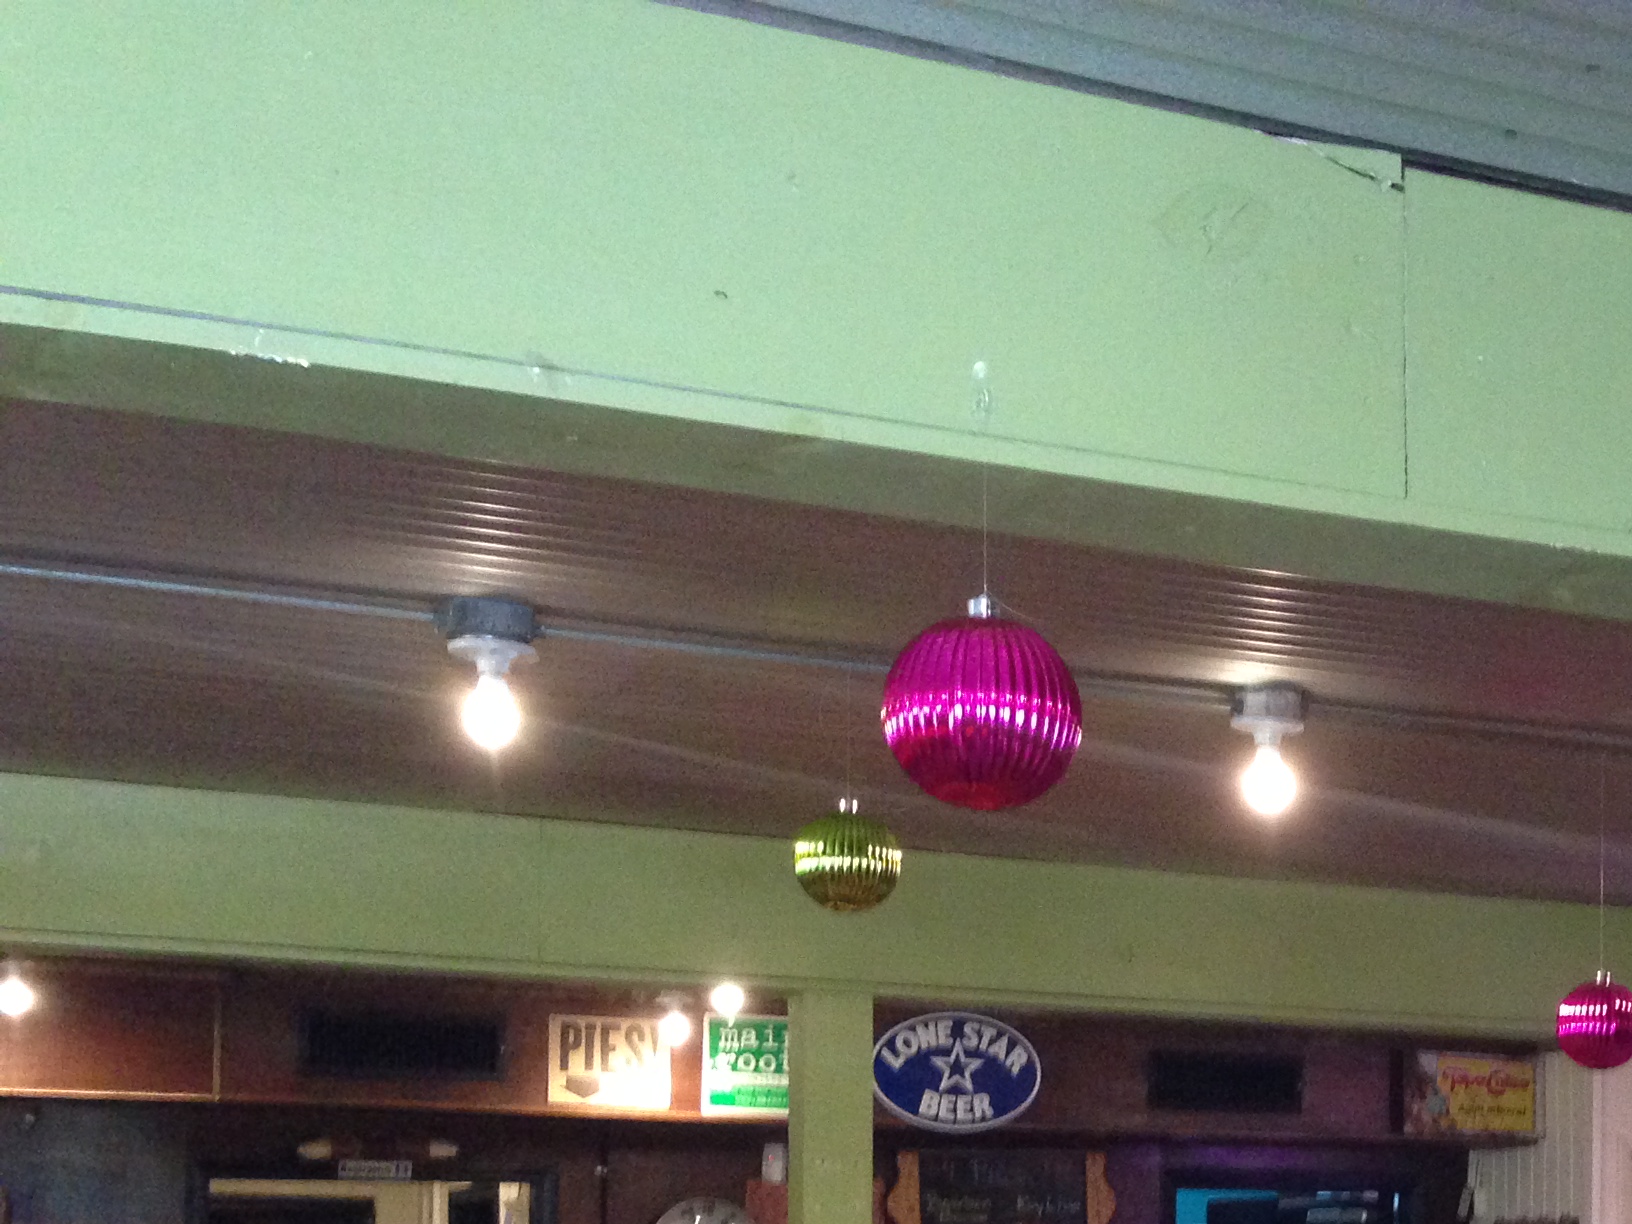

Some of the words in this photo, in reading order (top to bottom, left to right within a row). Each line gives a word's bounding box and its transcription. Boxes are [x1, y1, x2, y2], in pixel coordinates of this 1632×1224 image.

[880, 1019, 953, 1073] LONE
[962, 1021, 1029, 1077] STAR
[918, 1088, 994, 1124] BEER
